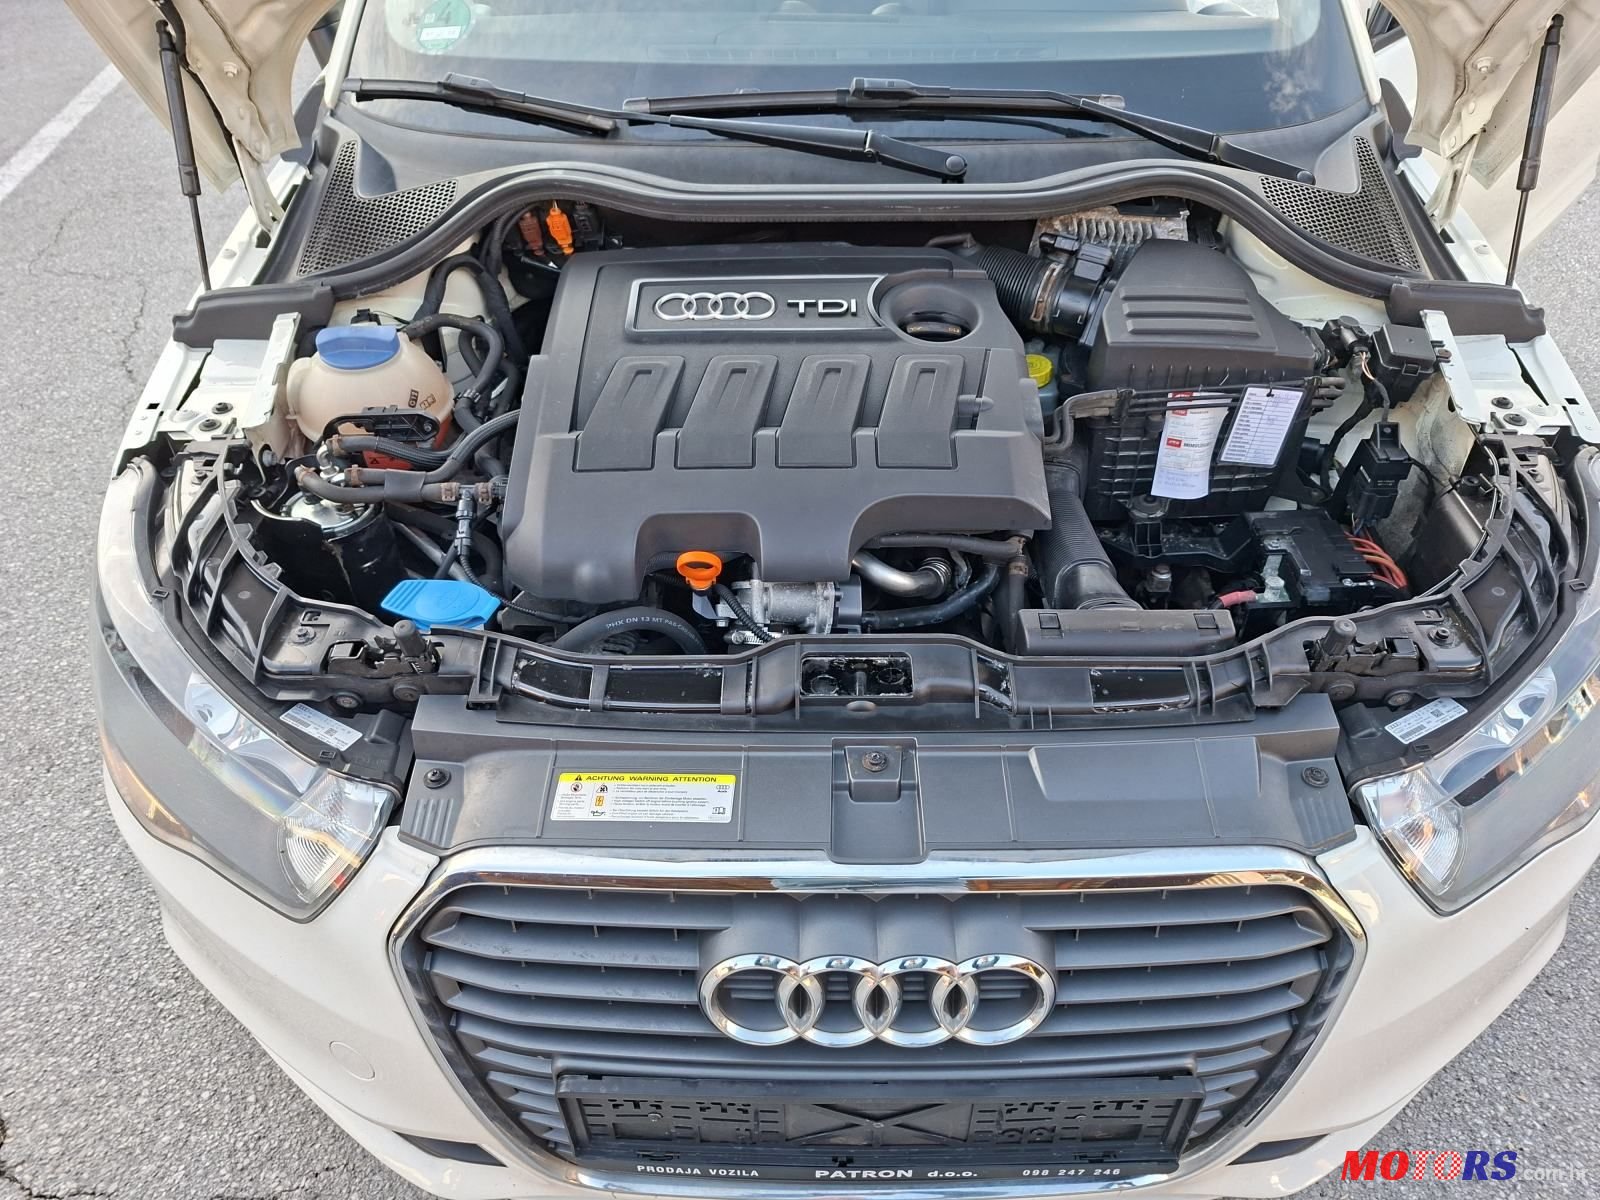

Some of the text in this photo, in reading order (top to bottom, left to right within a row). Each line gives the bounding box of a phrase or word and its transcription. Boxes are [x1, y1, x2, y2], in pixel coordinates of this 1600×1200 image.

[787, 298, 858, 316] TDI
[606, 619, 624, 629] PHX
[626, 616, 638, 624] DN
[629, 775, 669, 783] WARNING
[636, 1165, 760, 1178] PRODAJA VOZILA
[815, 1169, 913, 1179] PATRON
[927, 1170, 978, 1178] d.o.o.
[1022, 1169, 1050, 1177] 098
[1057, 1168, 1086, 1176] 247
